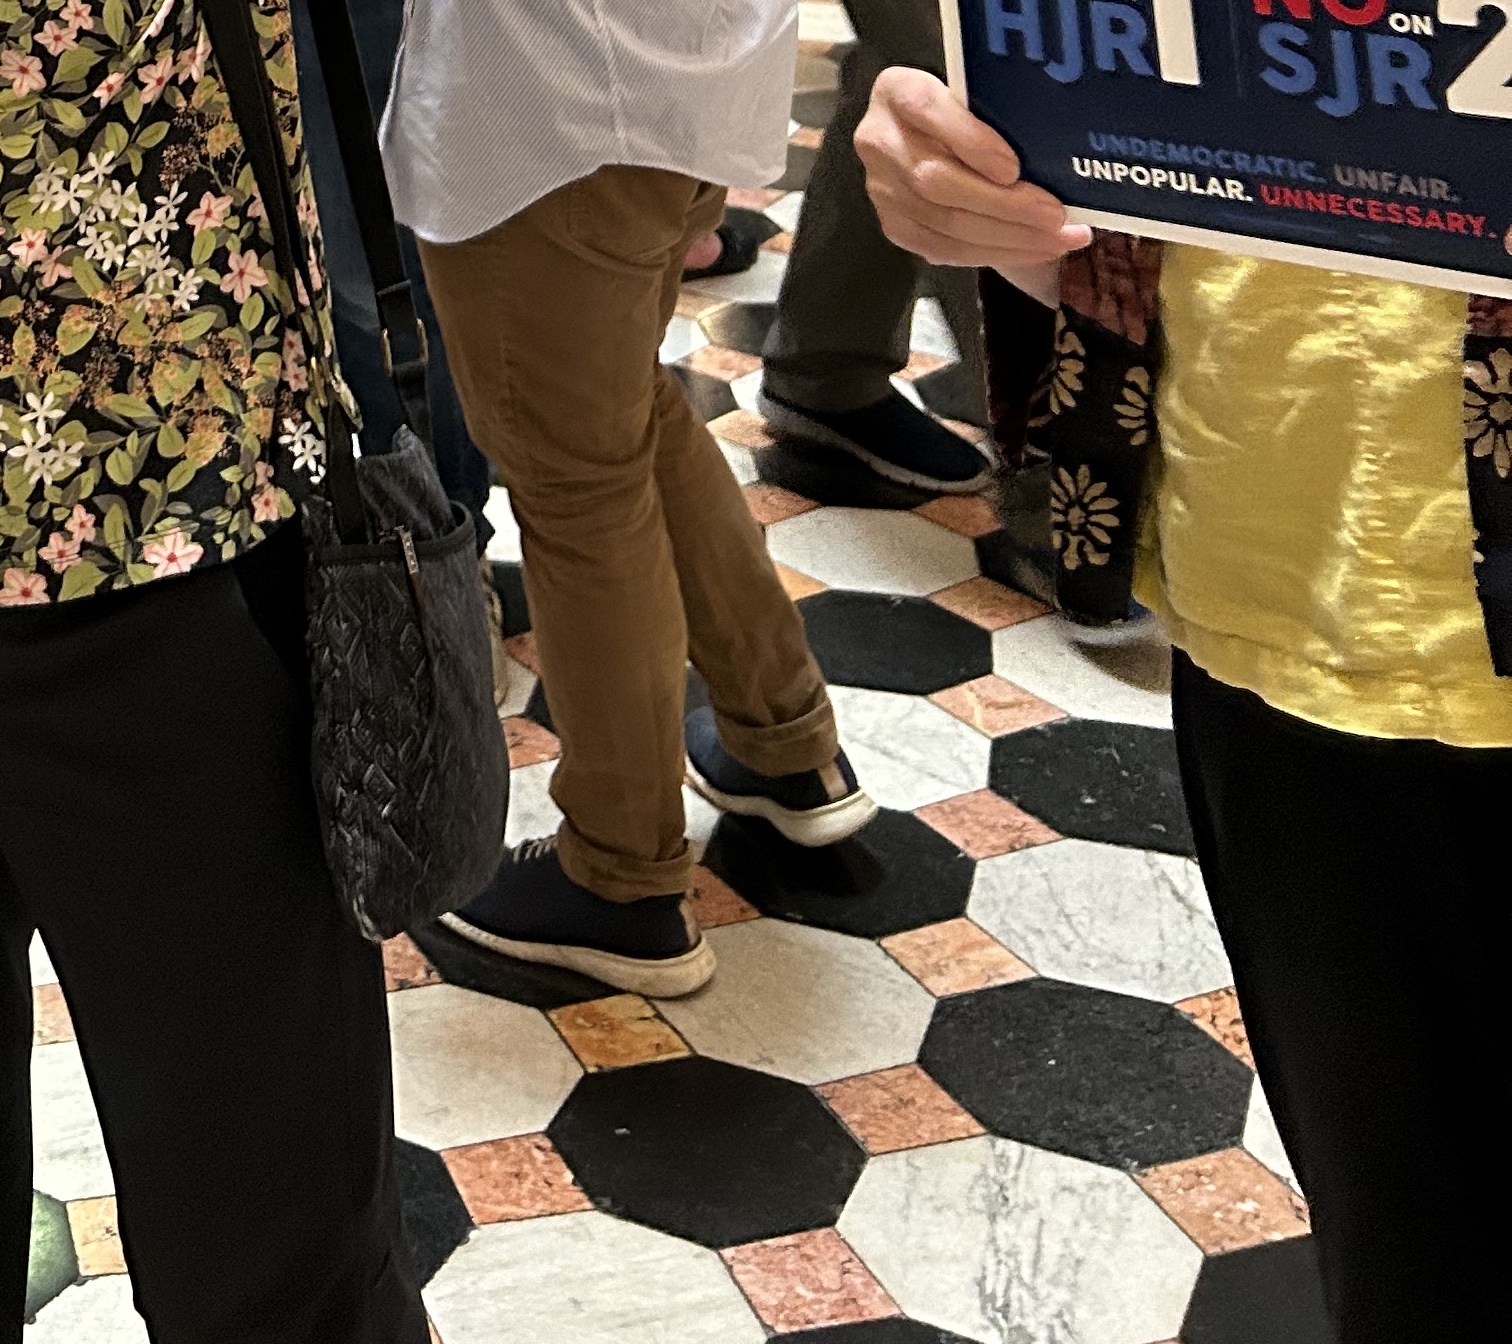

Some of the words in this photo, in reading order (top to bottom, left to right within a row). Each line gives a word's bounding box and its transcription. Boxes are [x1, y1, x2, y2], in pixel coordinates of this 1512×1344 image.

[1389, 12, 1433, 37] ON
[1257, 22, 1439, 118] SJR
[1071, 156, 1254, 202] UNPOPULAR.
[1259, 182, 1498, 239] UNNECESSARY.
[1089, 130, 1327, 184] UNDEMOCRATIC.
[1334, 162, 1462, 204] UNFAIR.
